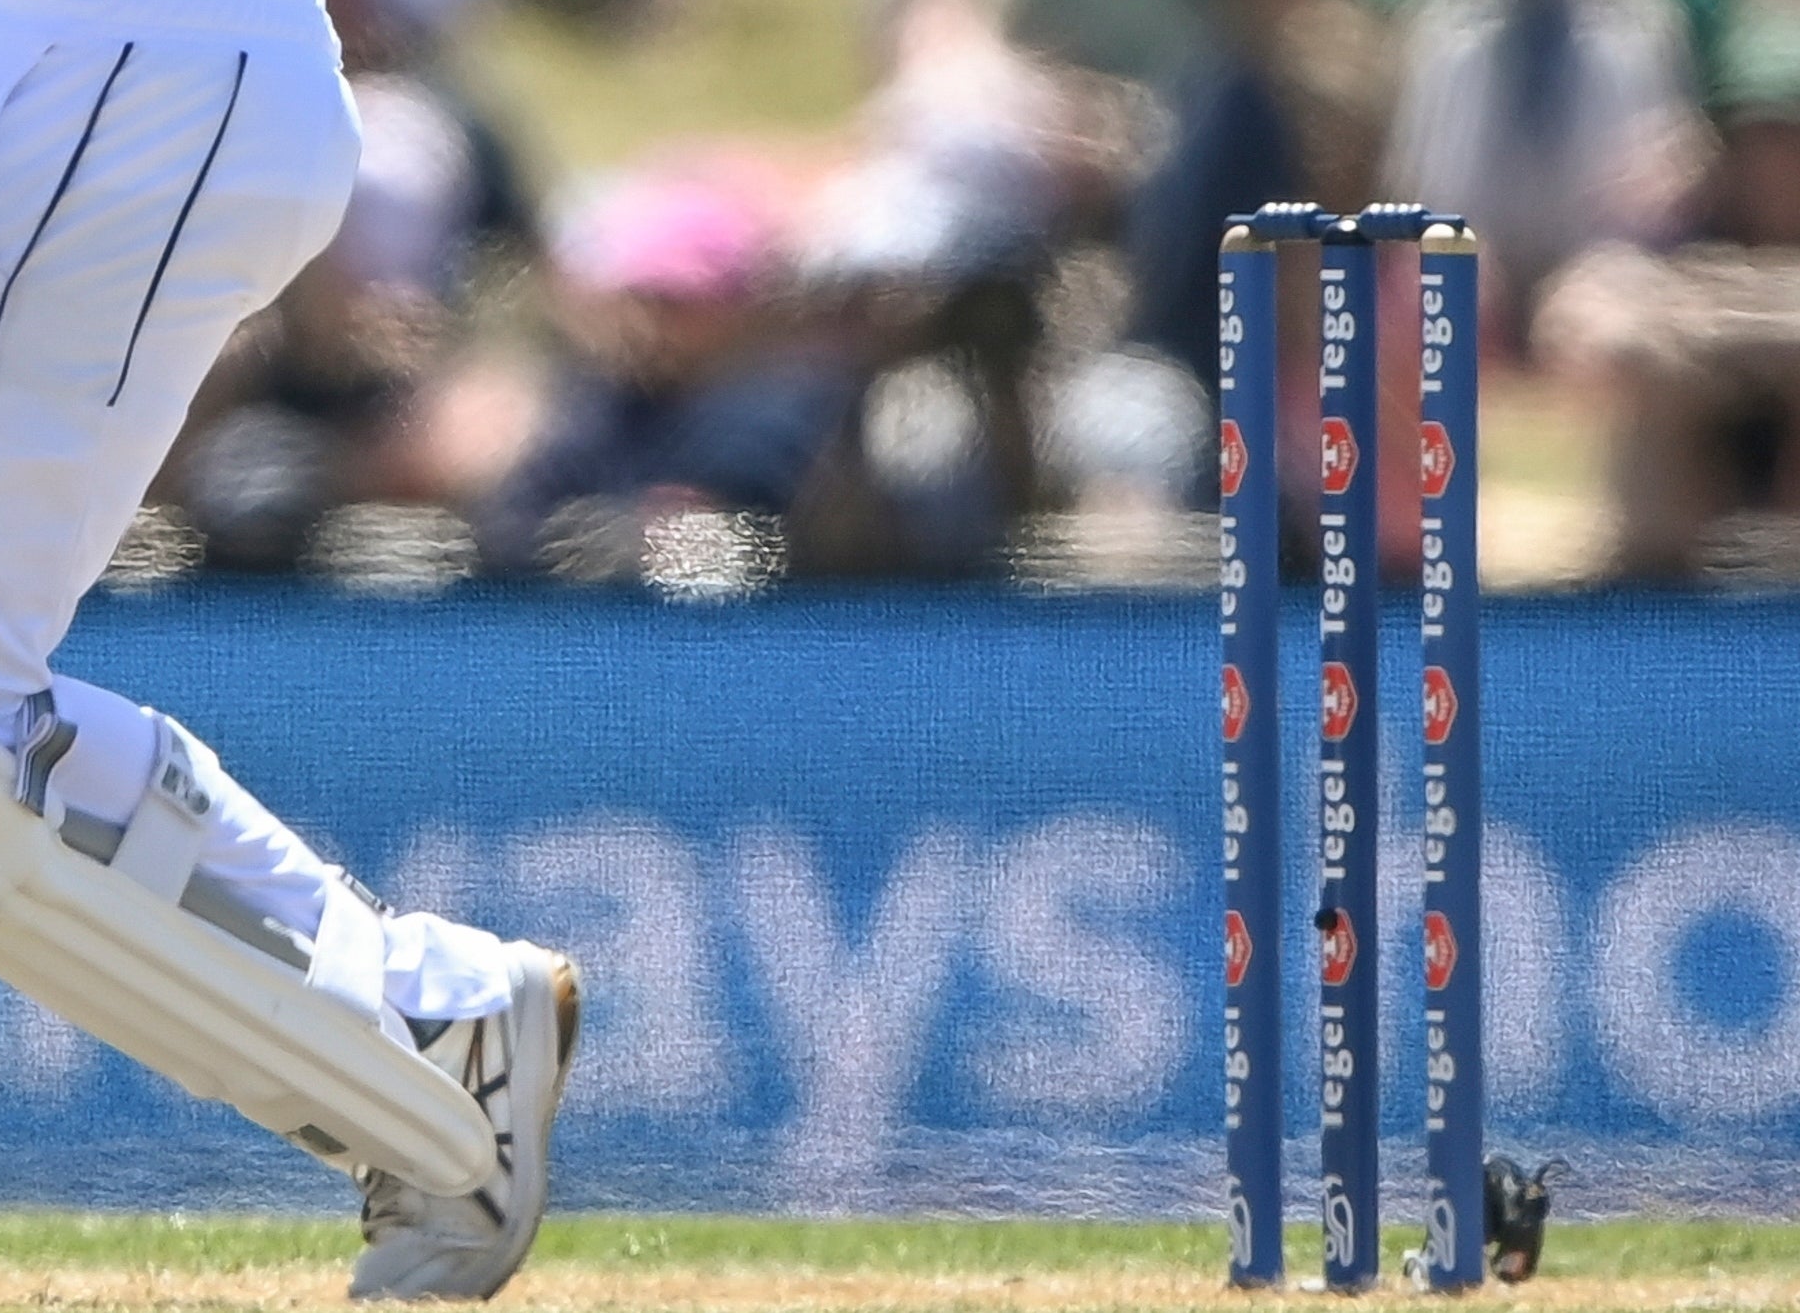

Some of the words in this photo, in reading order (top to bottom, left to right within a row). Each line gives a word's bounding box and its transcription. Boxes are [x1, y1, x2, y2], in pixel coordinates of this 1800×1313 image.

[1320, 269, 1355, 396] Tegel
[1420, 273, 1453, 398] Tegel
[1320, 514, 1355, 642] Tegel
[1421, 518, 1453, 644] Tegel
[1321, 760, 1355, 883] Tegel
[1321, 1005, 1354, 1130] Tegel
